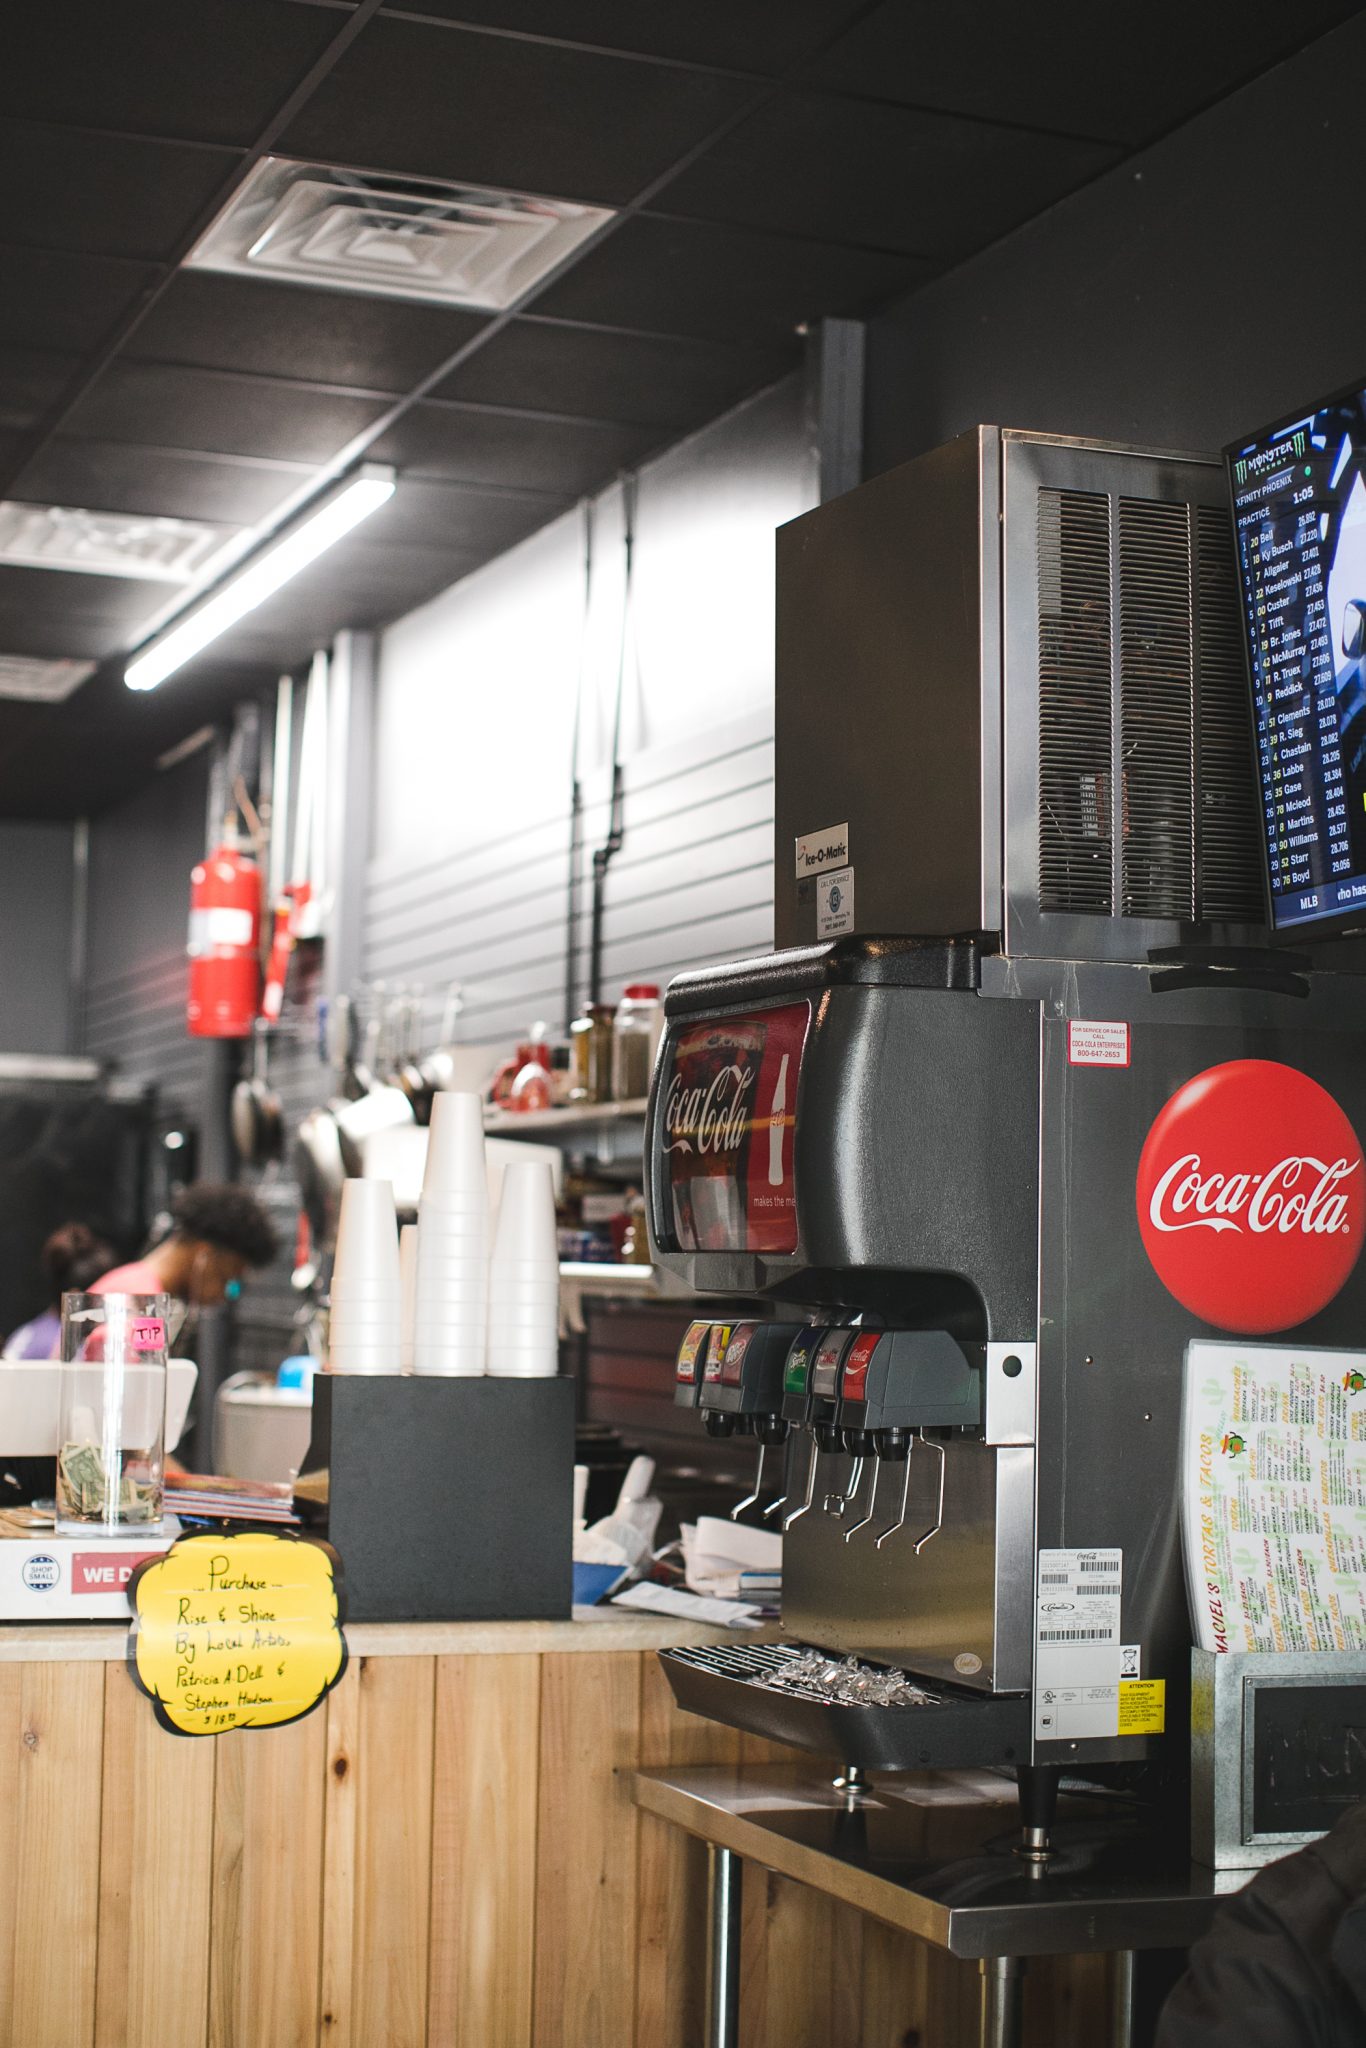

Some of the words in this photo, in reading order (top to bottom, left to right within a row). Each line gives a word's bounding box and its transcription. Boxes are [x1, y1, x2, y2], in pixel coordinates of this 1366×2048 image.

[1248, 441, 1293, 470] MONSTER
[1236, 489, 1261, 508] XFINITY
[1262, 474, 1292, 495] PHOENIX
[1293, 485, 1314, 504] 1:05
[1238, 506, 1271, 528] PRACTICE
[1250, 537, 1258, 548] 20
[1260, 529, 1274, 544] Bell
[1253, 554, 1260, 565] 18
[1261, 550, 1271, 561] Ky
[1271, 540, 1294, 557] Busch
[1264, 561, 1289, 578] Allgaier
[1256, 588, 1264, 599] 22
[1265, 572, 1302, 595] Keselowski
[1257, 605, 1266, 616] 00
[1267, 597, 1290, 612] Custer
[1261, 640, 1268, 651] 19
[1270, 636, 1280, 647] Br.
[1281, 629, 1302, 643] Jones
[1262, 657, 1271, 667] 42
[1272, 645, 1307, 665] McMurray
[1273, 671, 1281, 682] R.
[1281, 665, 1301, 679] Truex
[1256, 696, 1263, 707] 10
[1275, 681, 1304, 700] Reddick
[1258, 720, 1265, 731] 21
[1268, 717, 1275, 728] 51
[1277, 706, 1310, 725] Clements
[1260, 738, 1268, 749] 22
[1270, 734, 1278, 746] 39
[1279, 731, 1287, 743] R.
[1287, 727, 1304, 739] Sieg
[1261, 755, 1269, 766] 23
[1281, 742, 1312, 760] Chastain
[1263, 772, 1271, 784] 24
[1273, 769, 1281, 781] 36
[1282, 763, 1304, 777] Labbe
[1264, 789, 1272, 801] 25
[1274, 787, 1283, 798] 35
[1284, 782, 1302, 795] Gase
[1266, 807, 1274, 818] 26
[1276, 804, 1284, 815] 78
[1268, 825, 1275, 836] 27
[1287, 815, 1315, 830] Martins
[1269, 842, 1277, 853] 28
[1279, 839, 1288, 850] 90
[1288, 832, 1318, 848] Williams
[805, 842, 847, 867] Ice-O-Matic
[1271, 860, 1279, 871] 29
[1281, 857, 1289, 868] 52
[1290, 853, 1309, 865] Starr
[1272, 877, 1280, 888] 30
[1283, 874, 1291, 886] 76
[1292, 868, 1310, 883] Boyd
[1300, 895, 1319, 910] MLB
[661, 1065, 756, 1154] Coca-Cola
[753, 1195, 773, 1207] makes
[773, 1194, 785, 1207] the
[1149, 1153, 1360, 1234] Coca-Cola
[136, 1327, 161, 1344] TIP
[1199, 1434, 1213, 1487] TACOS
[1320, 1459, 1330, 1506] BURRITOS
[1200, 1496, 1213, 1508] &
[1201, 1514, 1217, 1575] TORTAS
[1323, 1511, 1340, 1573] QUESADILLAS
[82, 1566, 115, 1583] WE
[208, 1555, 267, 1592] Purchase
[177, 1597, 208, 1626] Rise
[239, 1602, 277, 1624] Shine
[175, 1631, 196, 1664] By
[177, 1665, 220, 1688] Patricia
[184, 1692, 229, 1713] Stephen
